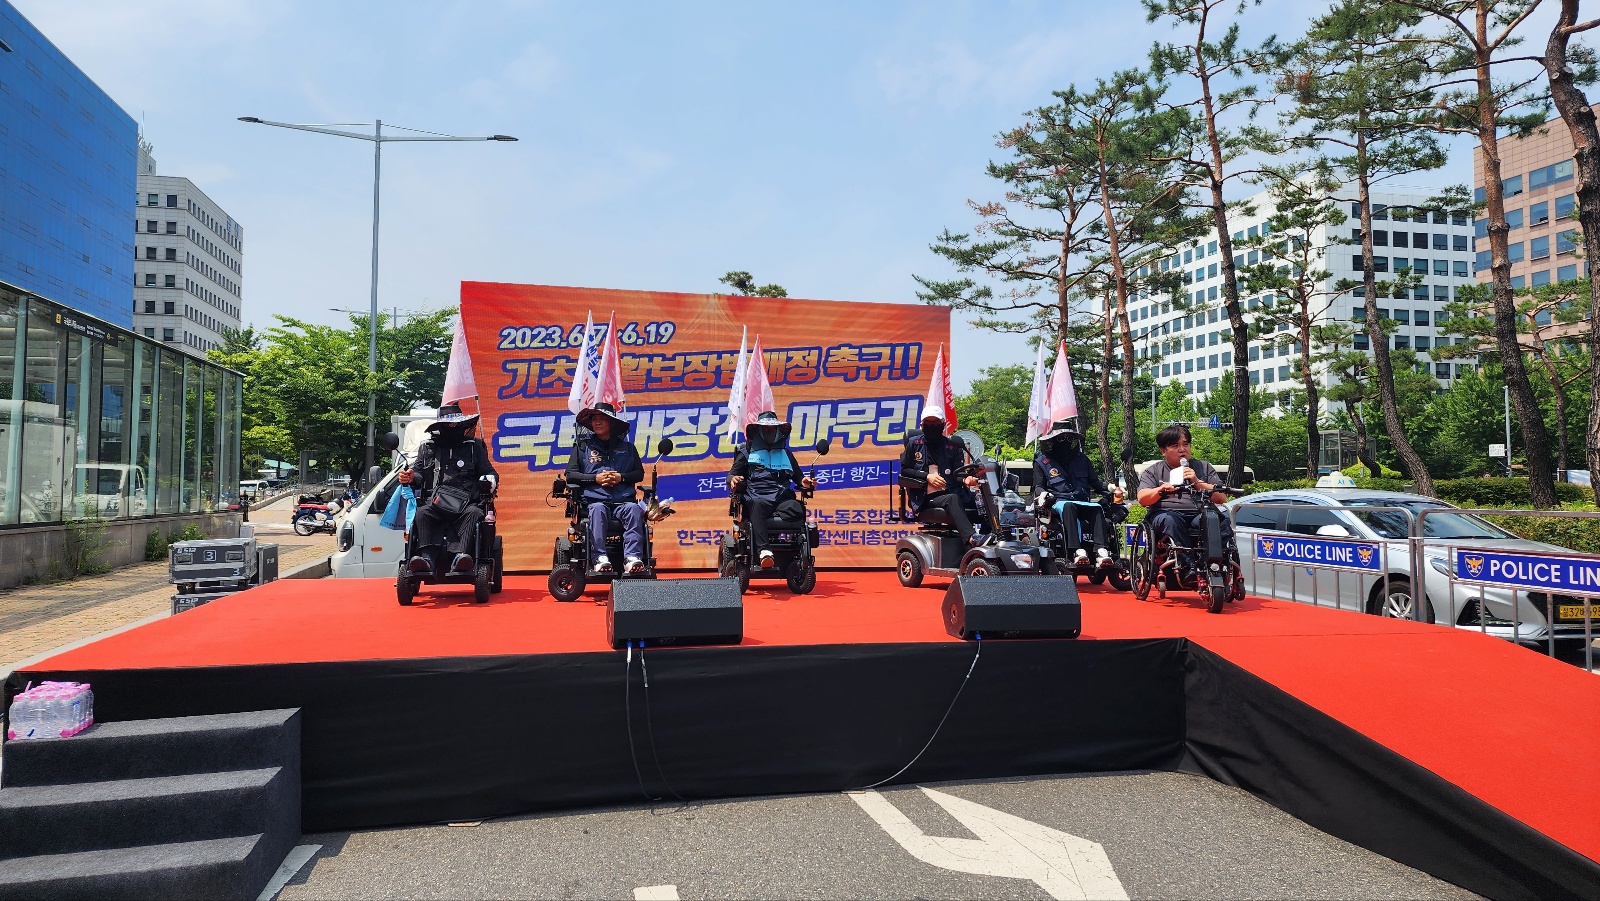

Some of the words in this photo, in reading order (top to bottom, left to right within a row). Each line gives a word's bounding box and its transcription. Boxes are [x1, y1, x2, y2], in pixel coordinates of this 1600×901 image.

[823, 346, 919, 381] 촉구!!
[788, 399, 920, 449] 마무리
[815, 468, 847, 484] 종단
[205, 551, 214, 560] 3
[1277, 542, 1322, 560] POLICE
[1325, 545, 1354, 563] LINE
[232, 568, 241, 576] 3
[1490, 559, 1561, 583] POLICE
